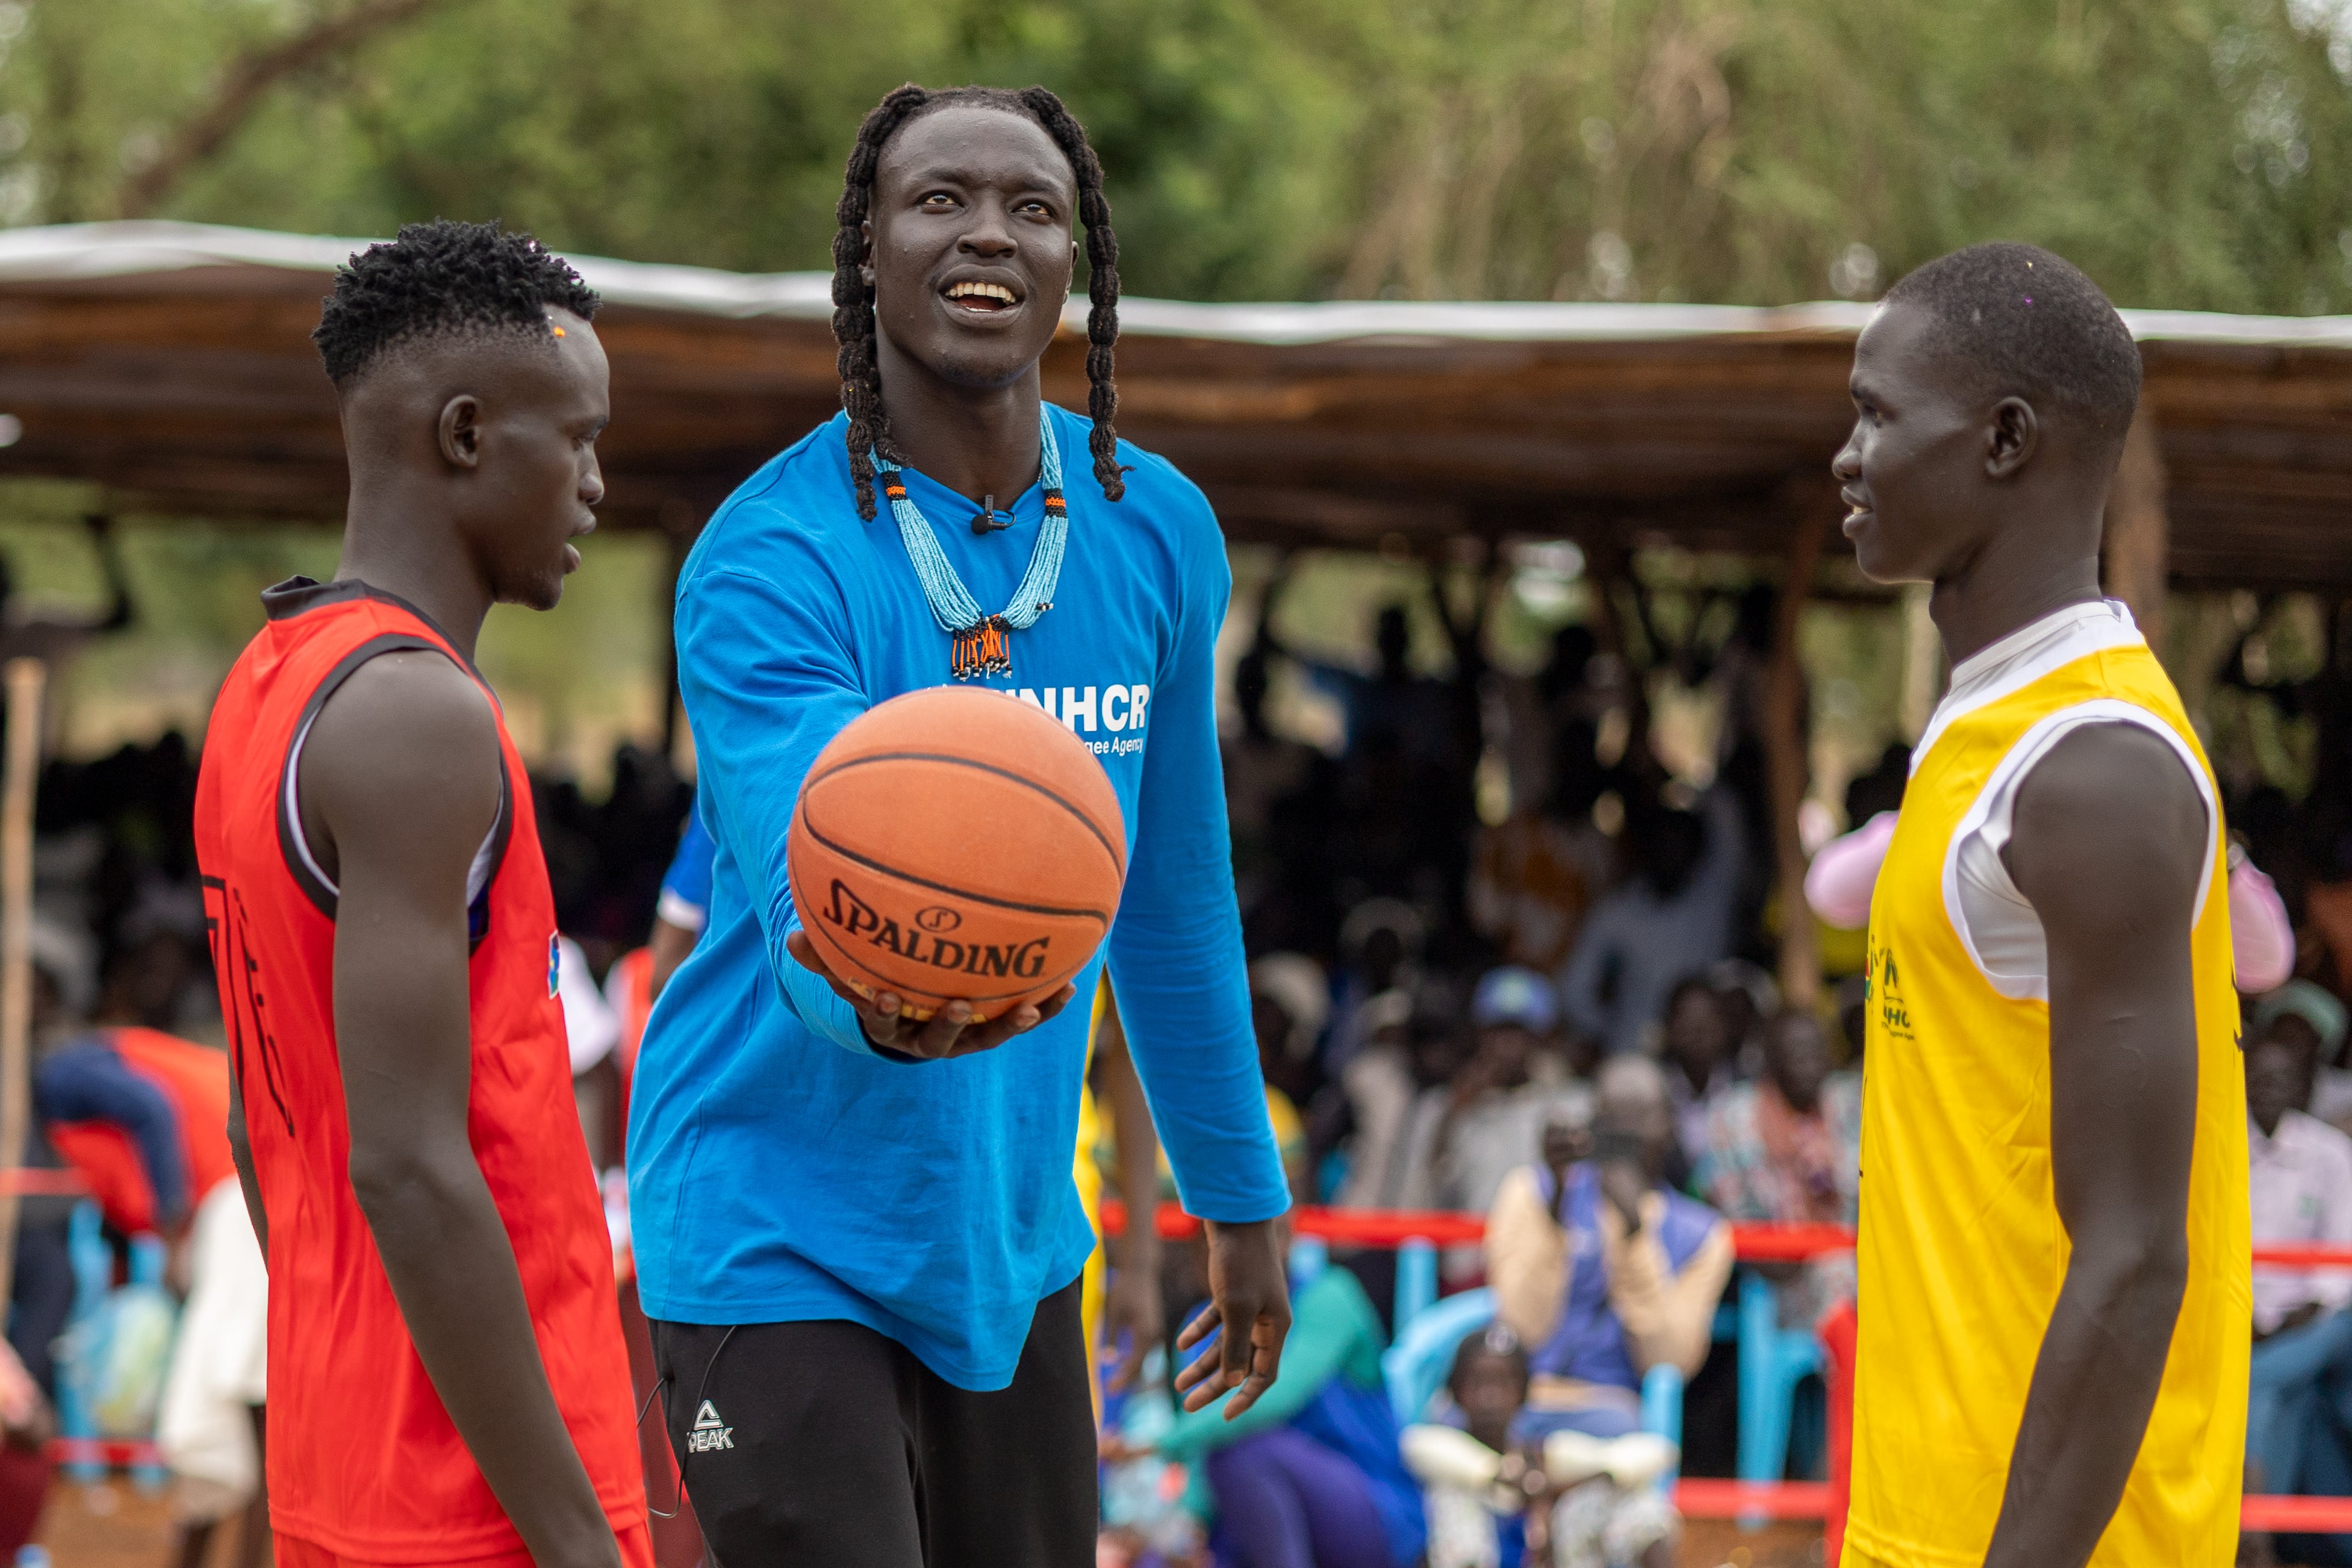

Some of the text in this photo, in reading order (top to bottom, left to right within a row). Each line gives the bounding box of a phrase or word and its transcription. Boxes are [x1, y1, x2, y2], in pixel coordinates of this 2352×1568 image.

[1111, 736, 1143, 757] Agency
[824, 879, 1050, 978] SPALDING
[686, 1427, 734, 1453] PEAK
